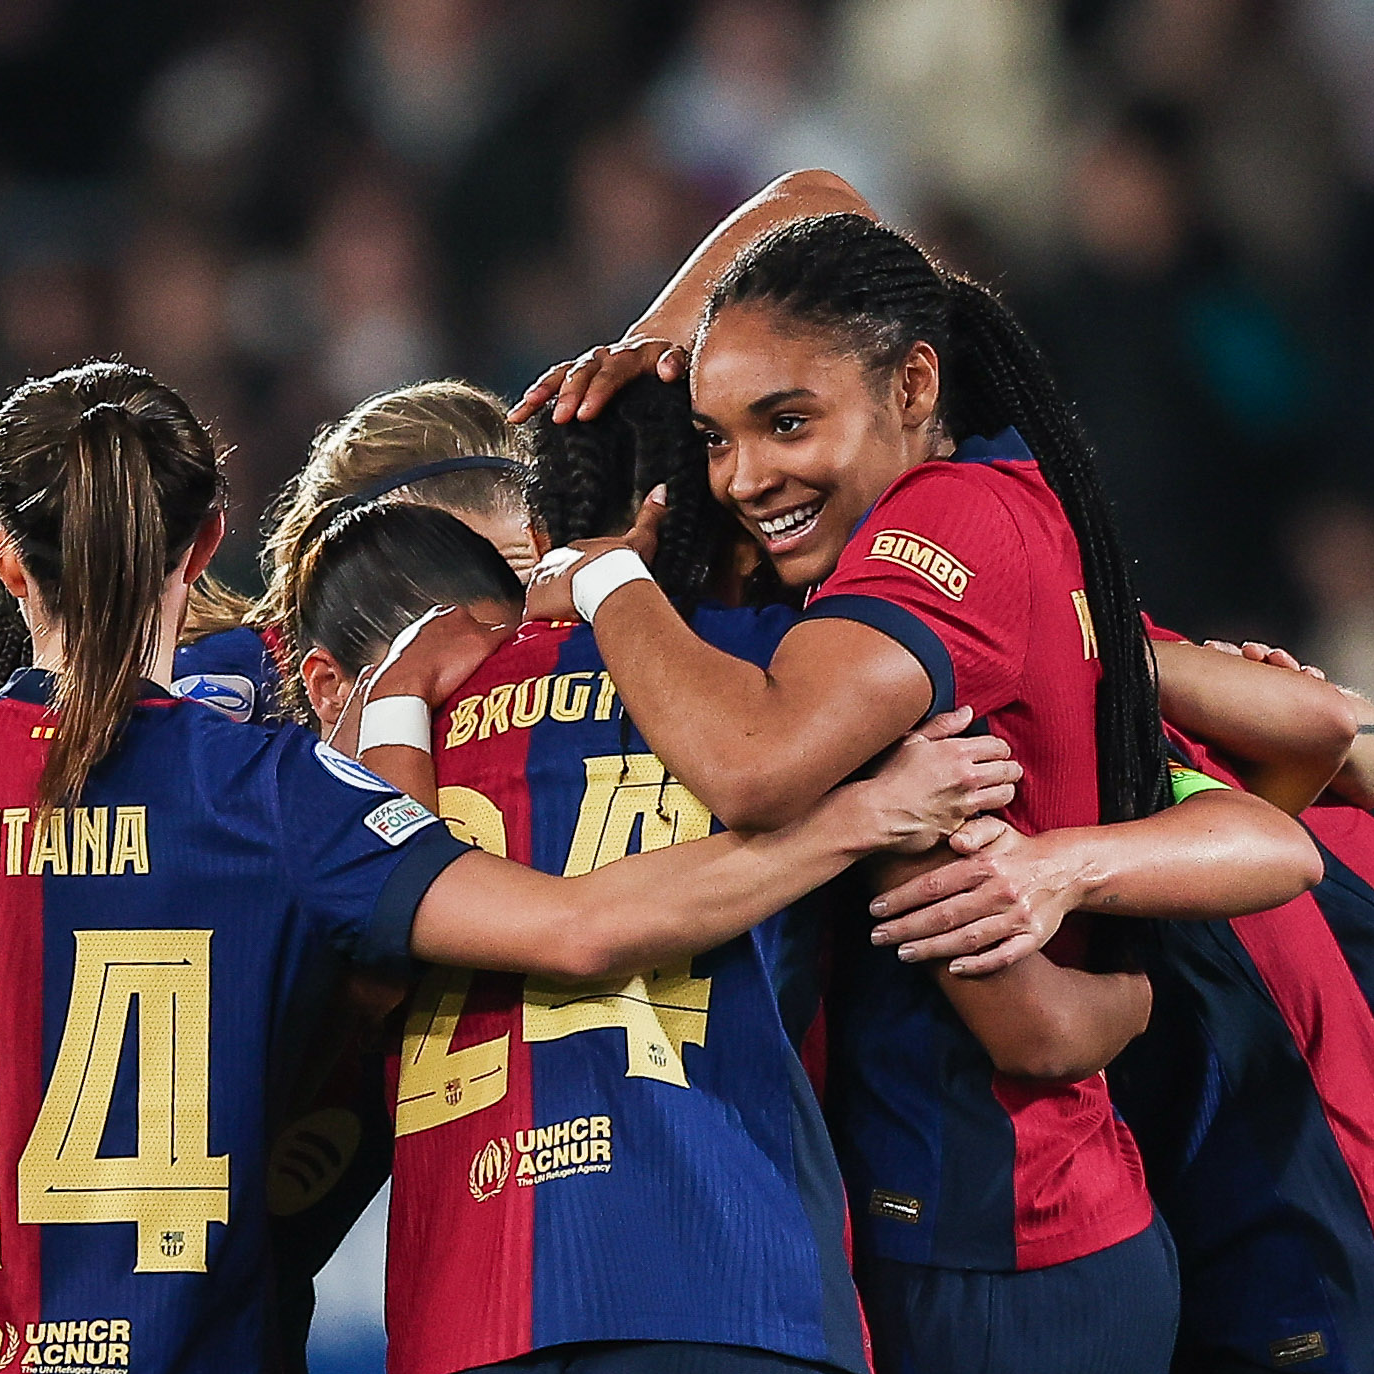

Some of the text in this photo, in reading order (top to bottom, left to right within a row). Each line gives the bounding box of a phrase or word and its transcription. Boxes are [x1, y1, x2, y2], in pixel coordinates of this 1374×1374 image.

[871, 535, 968, 595] BIMBO
[444, 671, 624, 750] BRUGT
[369, 806, 394, 825] UEFA
[395, 753, 714, 1137] 24
[515, 1116, 612, 1153] UNHCR
[515, 1139, 612, 1177] ACNUR
[516, 1178, 534, 1187] The
[534, 1173, 545, 1184] UN
[577, 1164, 612, 1174] Agency
[25, 1319, 131, 1344] UNHCR
[21, 1342, 129, 1366] ACNUR
[21, 1366, 37, 1374] The
[39, 1366, 53, 1374] UN
